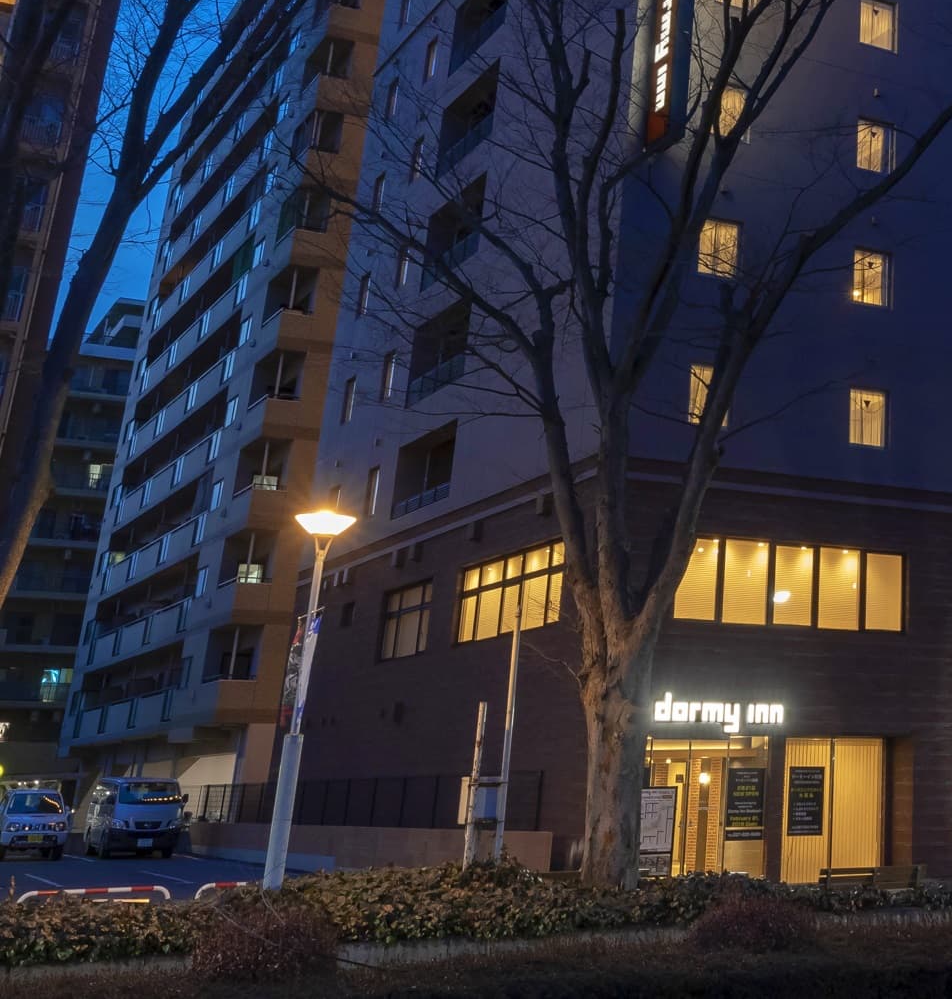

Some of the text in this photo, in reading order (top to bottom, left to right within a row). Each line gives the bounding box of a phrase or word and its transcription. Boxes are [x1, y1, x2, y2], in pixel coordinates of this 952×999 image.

[654, 64, 668, 112] inn
[653, 691, 785, 734] dormy inn
